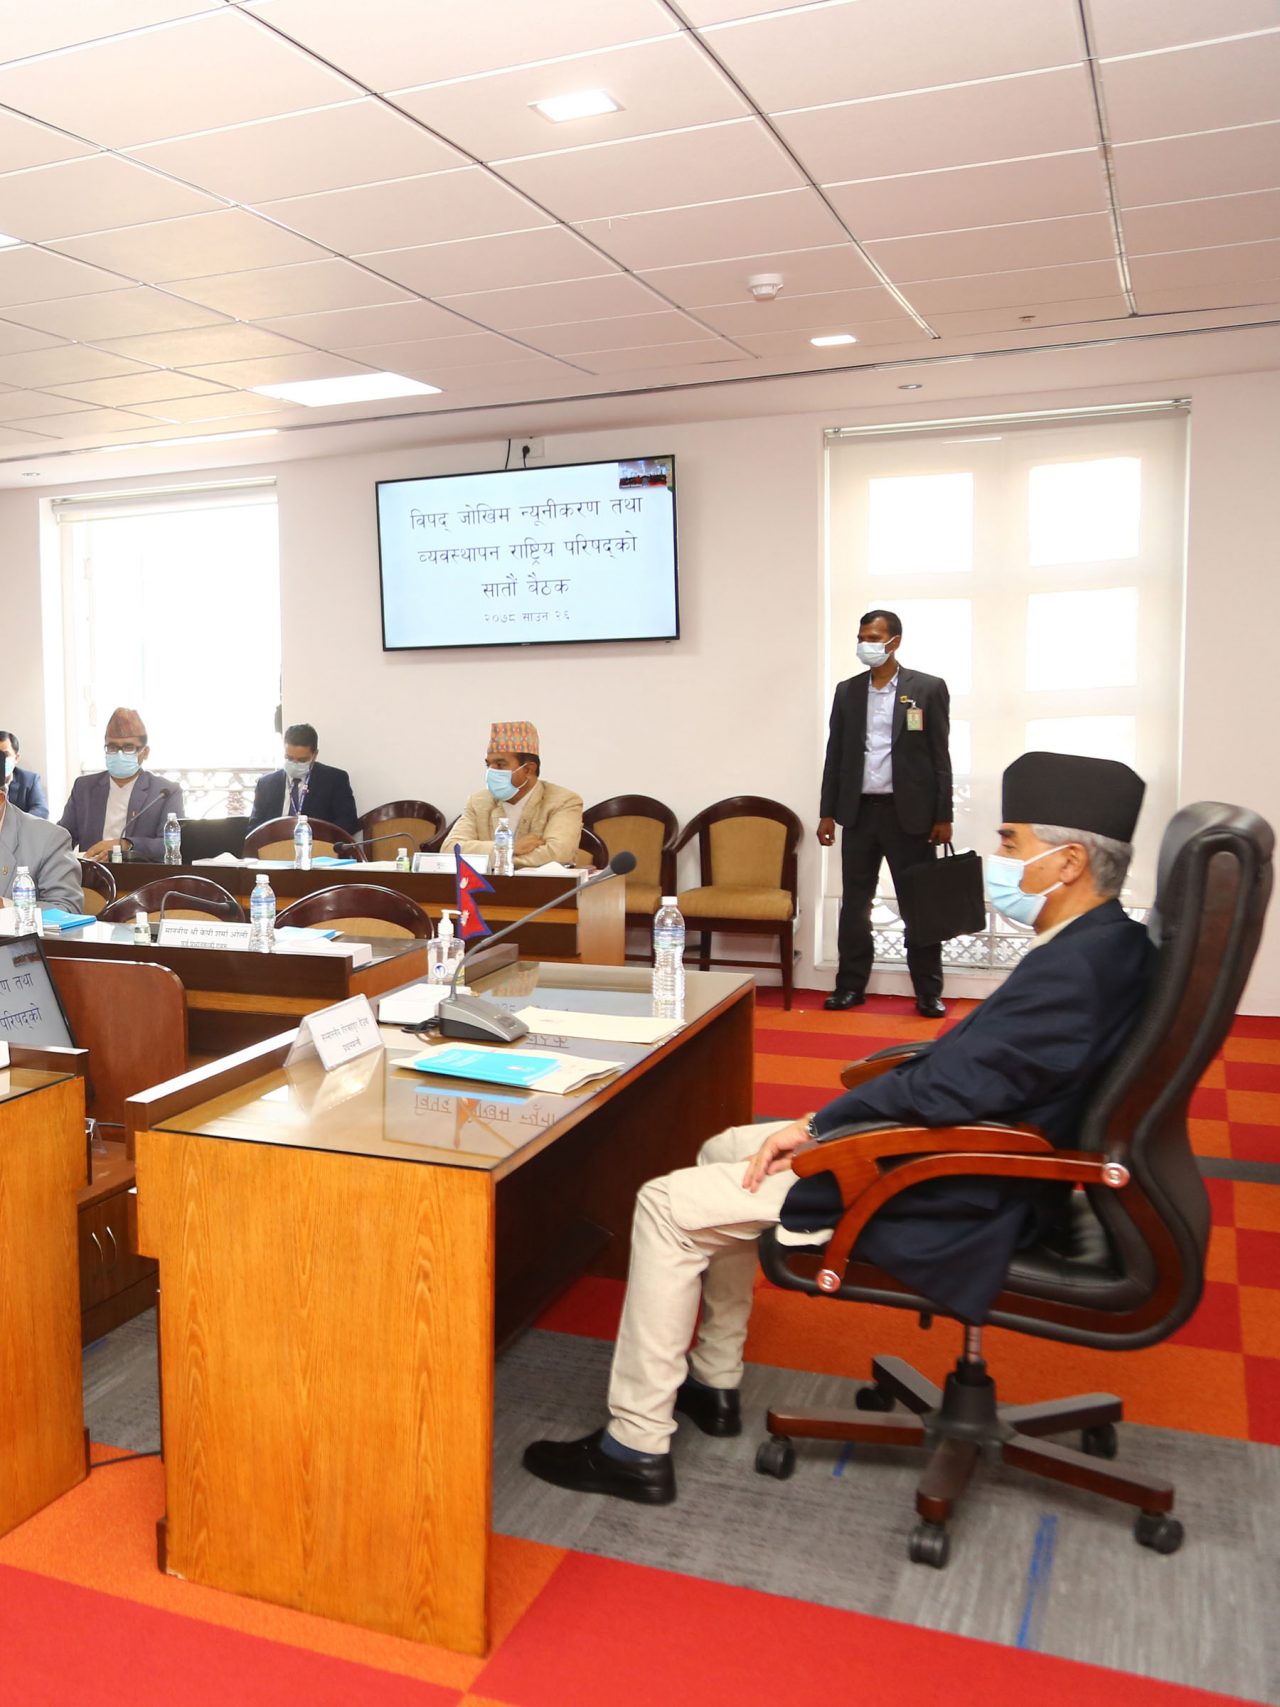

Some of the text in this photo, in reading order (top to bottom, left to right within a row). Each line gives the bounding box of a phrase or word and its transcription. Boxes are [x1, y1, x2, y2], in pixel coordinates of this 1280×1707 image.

[410, 497, 643, 532] विपद् जोखिम न्यूनीकरण तथा
[418, 545, 500, 565] व्यवस्थापन
[509, 537, 556, 565] राष्ट्रिय
[12, 973, 35, 990] तथा
